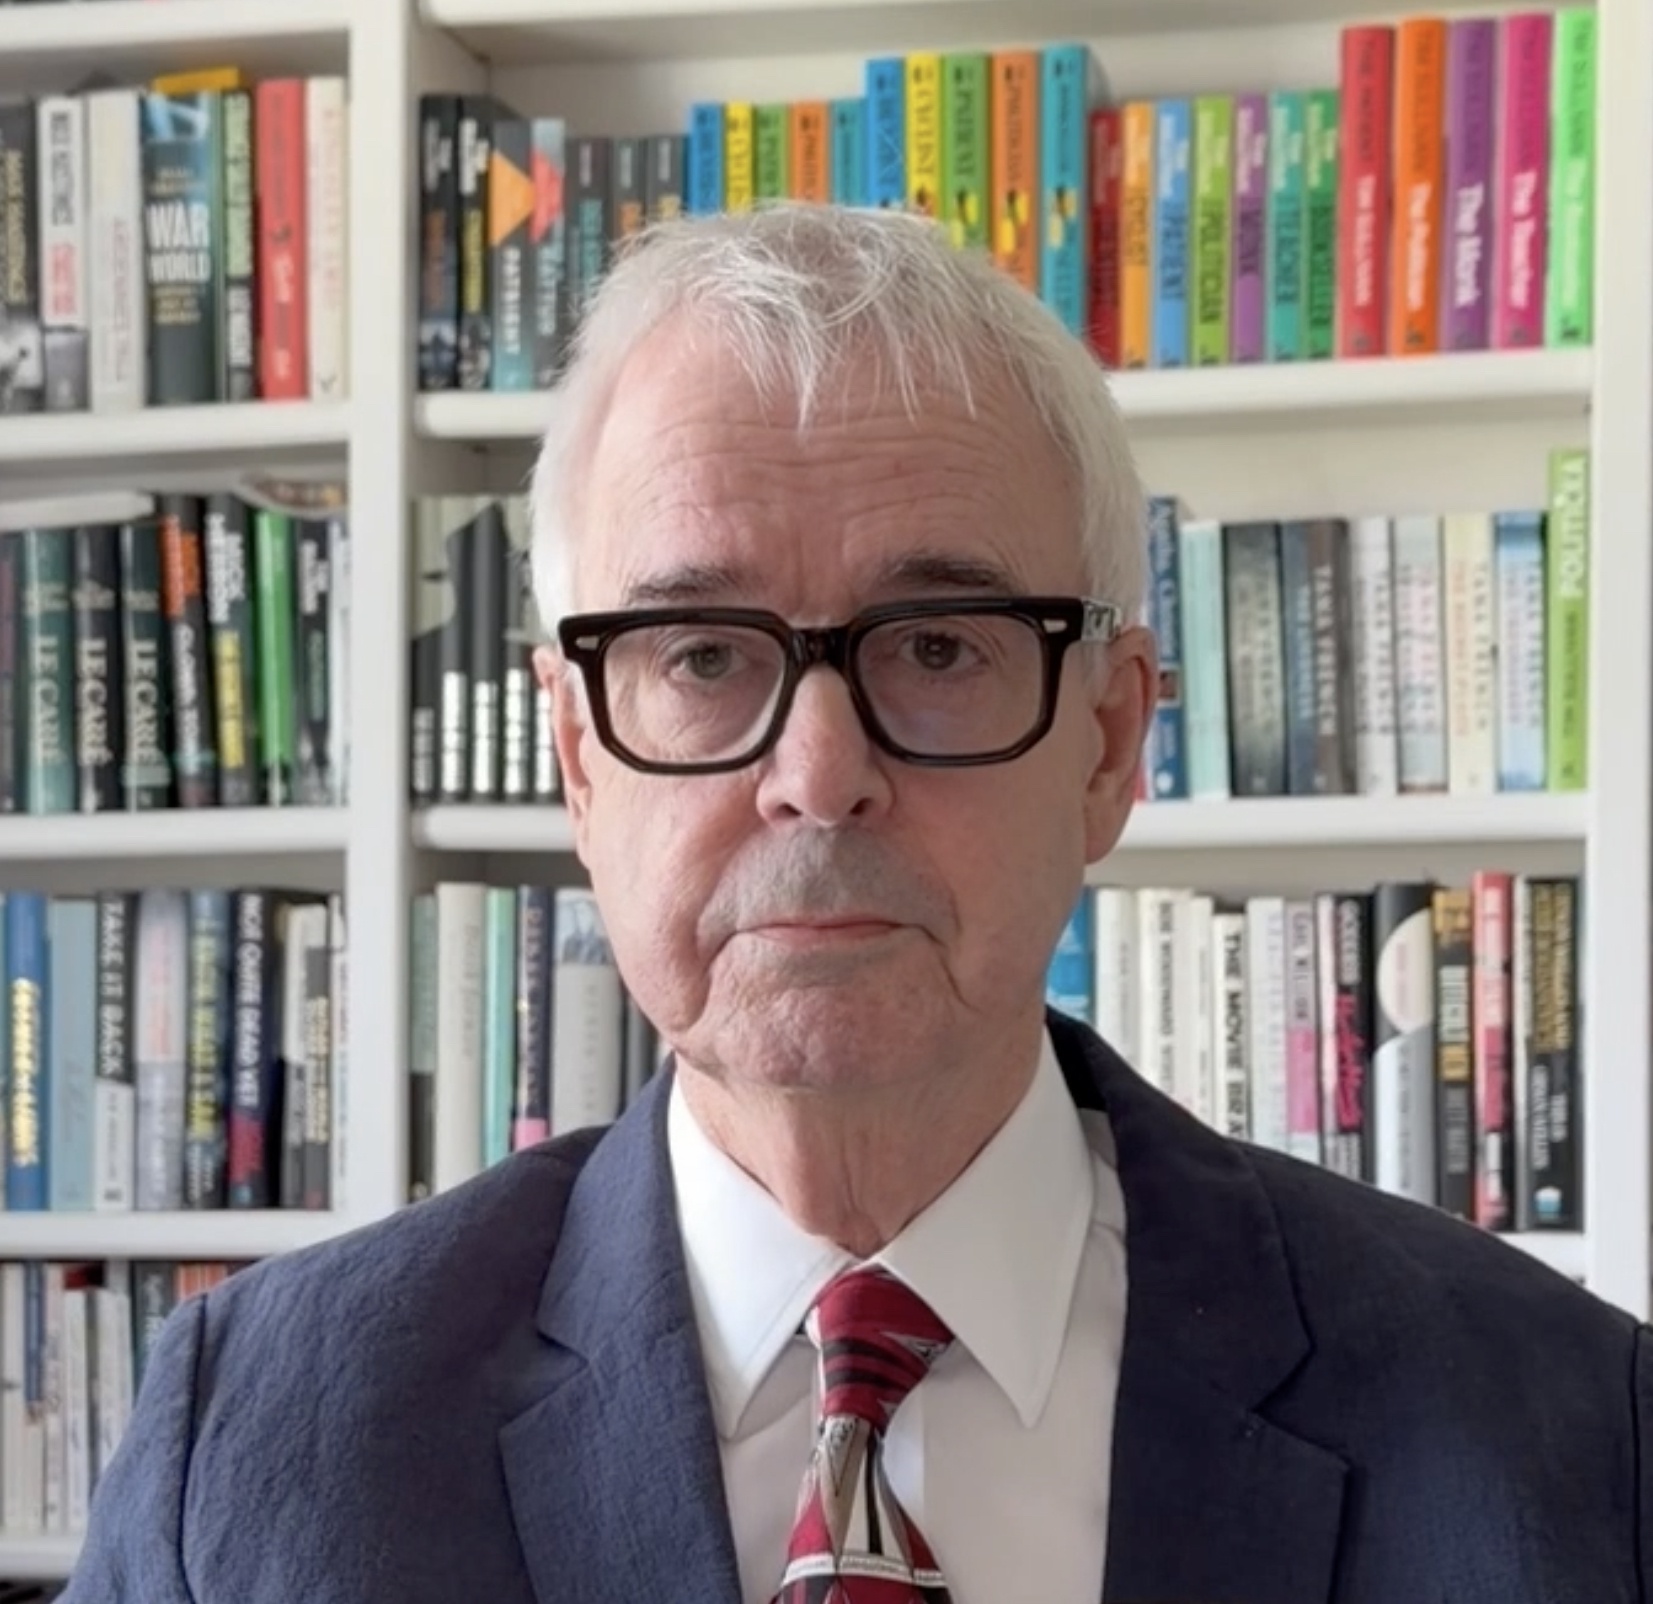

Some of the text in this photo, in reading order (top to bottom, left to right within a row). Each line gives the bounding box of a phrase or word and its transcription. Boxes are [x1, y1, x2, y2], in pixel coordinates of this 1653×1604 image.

[146, 201, 210, 250] WAR
[1454, 183, 1485, 309] The Monk
[150, 252, 212, 283] WORLD
[32, 635, 60, 675] LE
[79, 637, 108, 677] LE
[129, 639, 158, 678] LE
[1314, 563, 1337, 737] TANA FRENCH
[100, 901, 124, 966] TAKE
[239, 894, 262, 940] NOT
[100, 971, 124, 996] IT
[100, 1003, 124, 1076] BACK
[239, 1007, 261, 1066] DEAD
[1225, 933, 1245, 1138] THE MOVIE BRA
